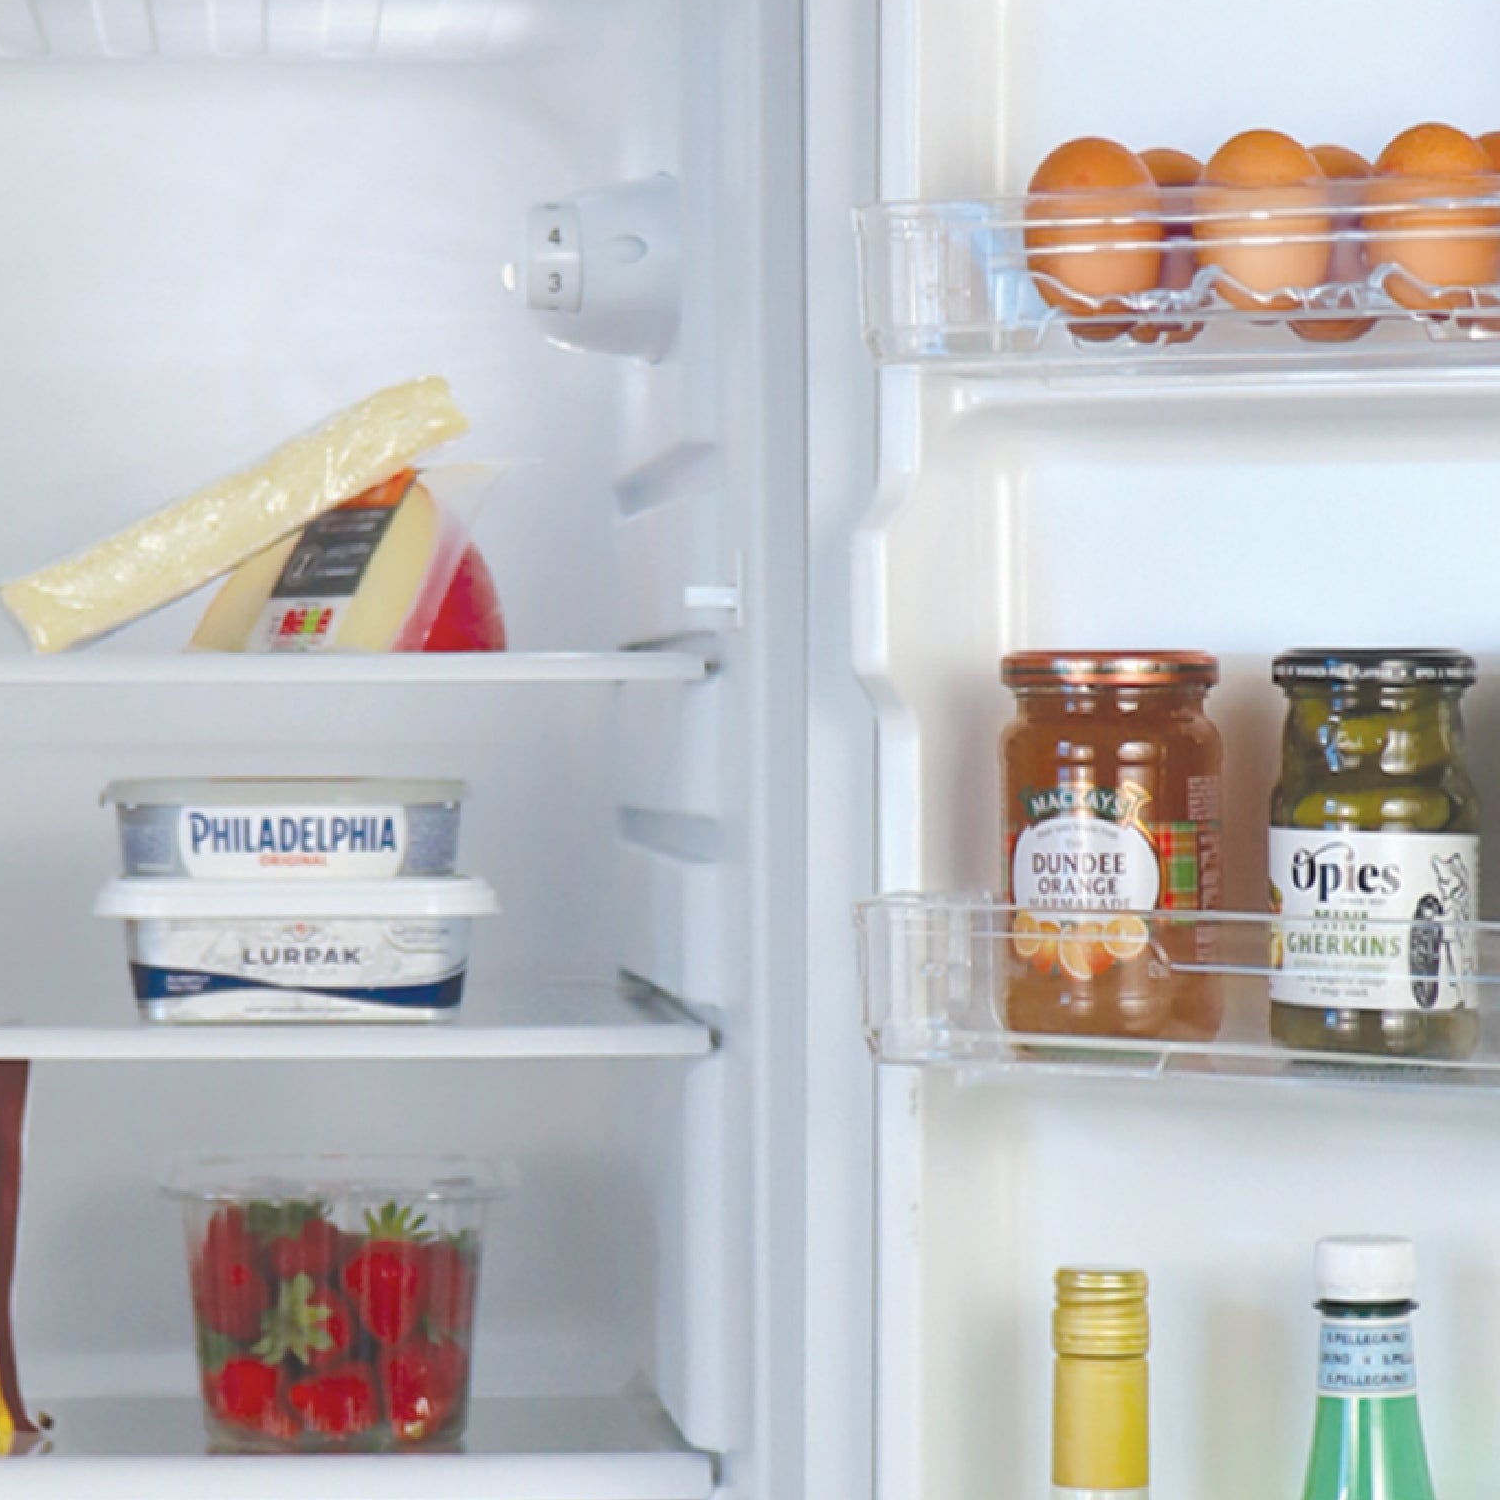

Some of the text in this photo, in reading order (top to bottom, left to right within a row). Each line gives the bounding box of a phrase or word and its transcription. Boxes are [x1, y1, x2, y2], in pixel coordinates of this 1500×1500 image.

[1031, 787, 1126, 817] MACAYS
[188, 812, 398, 854] PHILADELPHIA
[1031, 853, 1126, 875] DUNDEE
[1292, 842, 1402, 902] Opies
[1037, 876, 1118, 896] ORANGE
[241, 947, 362, 966] LURPAK
[1286, 931, 1403, 957] GHERKINS
